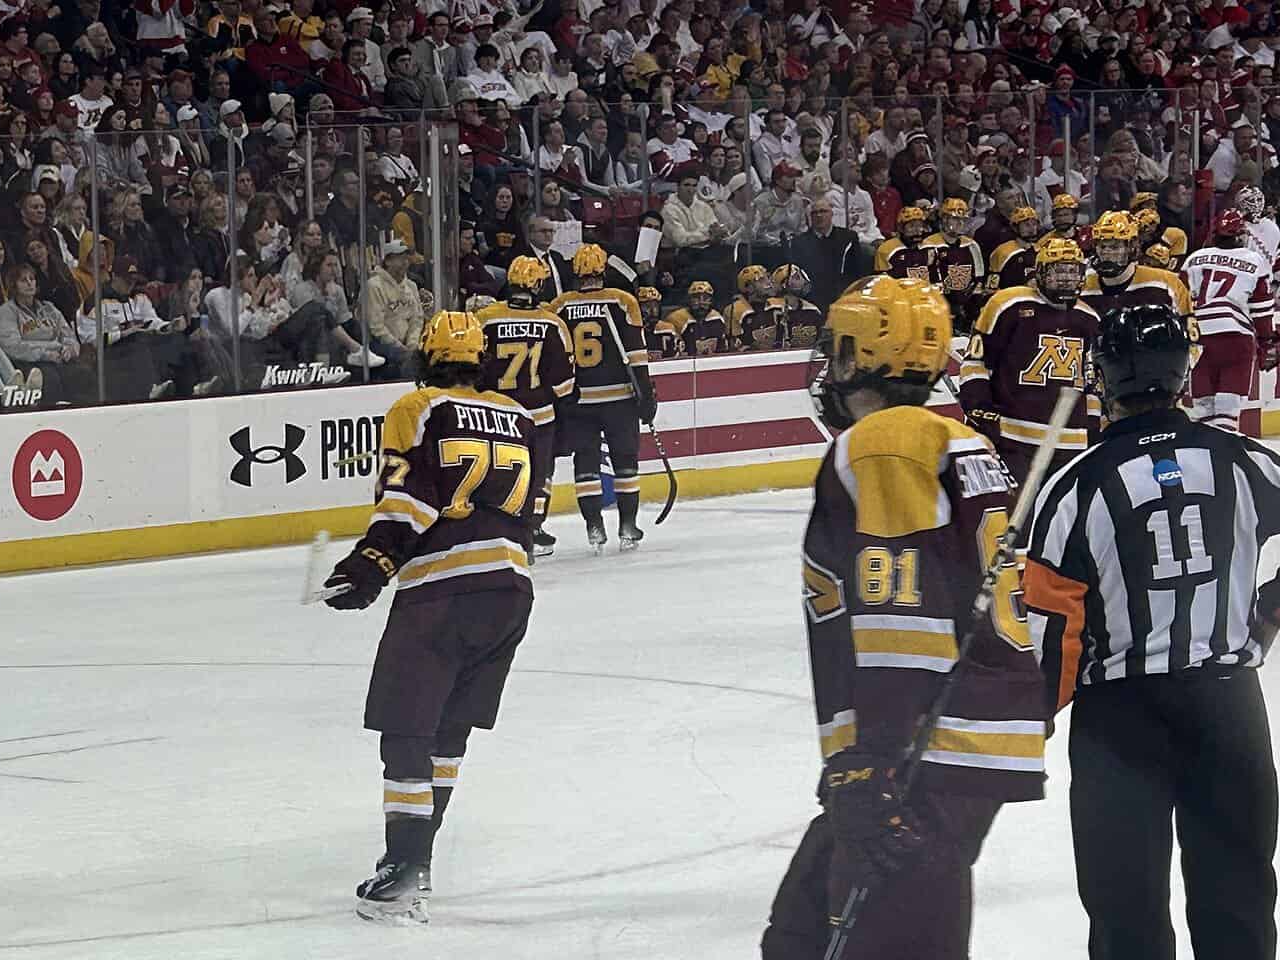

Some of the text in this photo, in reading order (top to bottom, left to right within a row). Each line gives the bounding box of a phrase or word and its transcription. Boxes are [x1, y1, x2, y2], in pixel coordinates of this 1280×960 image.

[1199, 269, 1237, 307] 17
[497, 324, 548, 339] CHESLEY
[573, 322, 602, 368] 6
[496, 341, 543, 390] 71
[1019, 334, 1084, 390] M
[454, 404, 523, 438] PITLICK
[1138, 432, 1176, 445] CCM
[439, 437, 532, 519] 77
[1146, 504, 1212, 580] 11
[856, 546, 922, 606] 81
